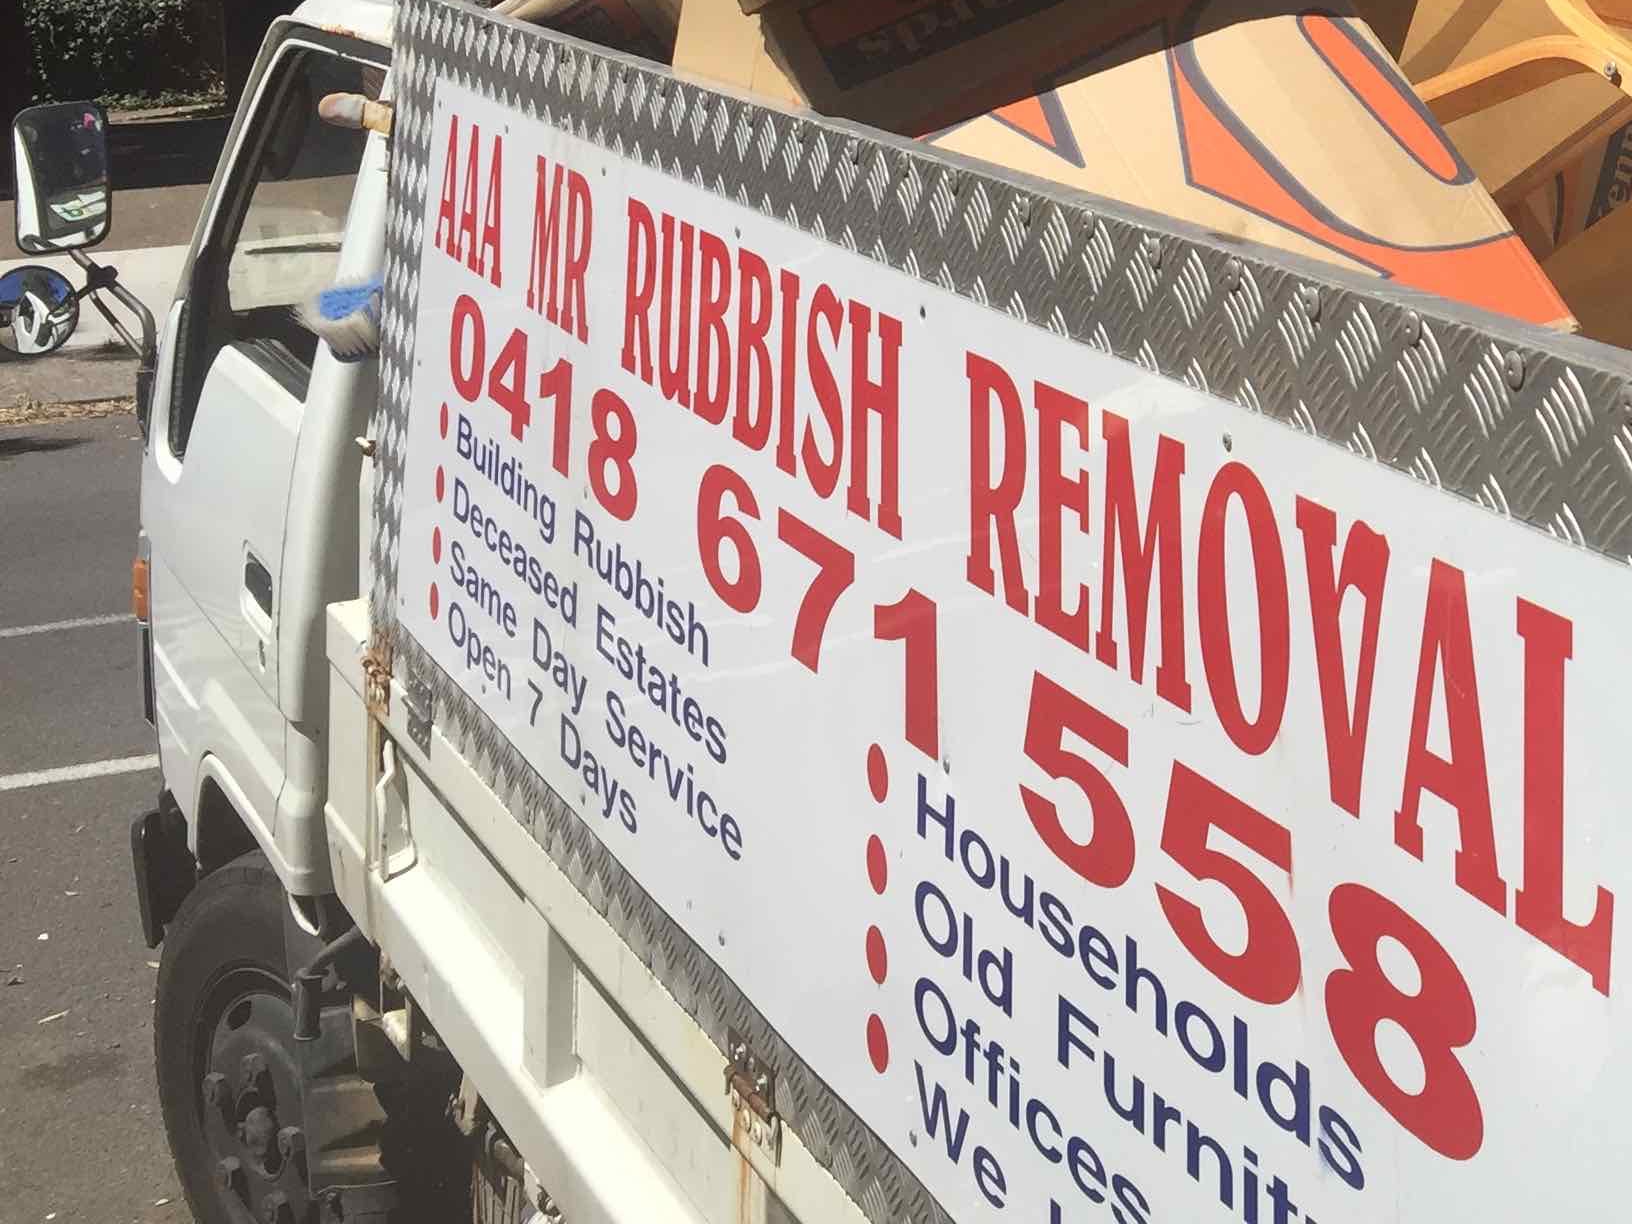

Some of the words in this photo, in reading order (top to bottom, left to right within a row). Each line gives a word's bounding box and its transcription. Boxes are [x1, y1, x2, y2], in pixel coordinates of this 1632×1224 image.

[435, 115, 502, 288] AAA
[526, 154, 593, 345] MR
[620, 197, 903, 541] RUBBISH
[965, 350, 1615, 998] REMOVAL
[453, 479, 577, 628] Deceased
[596, 603, 727, 765] Estates
[456, 414, 555, 544] Building
[573, 509, 710, 667] Rubbish
[448, 602, 511, 701] Open
[527, 679, 544, 728] 7
[560, 713, 638, 835] Days
[449, 541, 517, 638] Same
[533, 618, 587, 716] Day
[605, 690, 743, 861] Service
[449, 294, 639, 522] 0418
[697, 463, 940, 760] 671
[1018, 669, 1485, 1162] 558
[914, 880, 1013, 1018] Old
[1057, 993, 1320, 1224] Furnit
[914, 976, 1151, 1224] Offices
[916, 771, 1365, 1191] Households
[914, 1058, 1008, 1210] We
